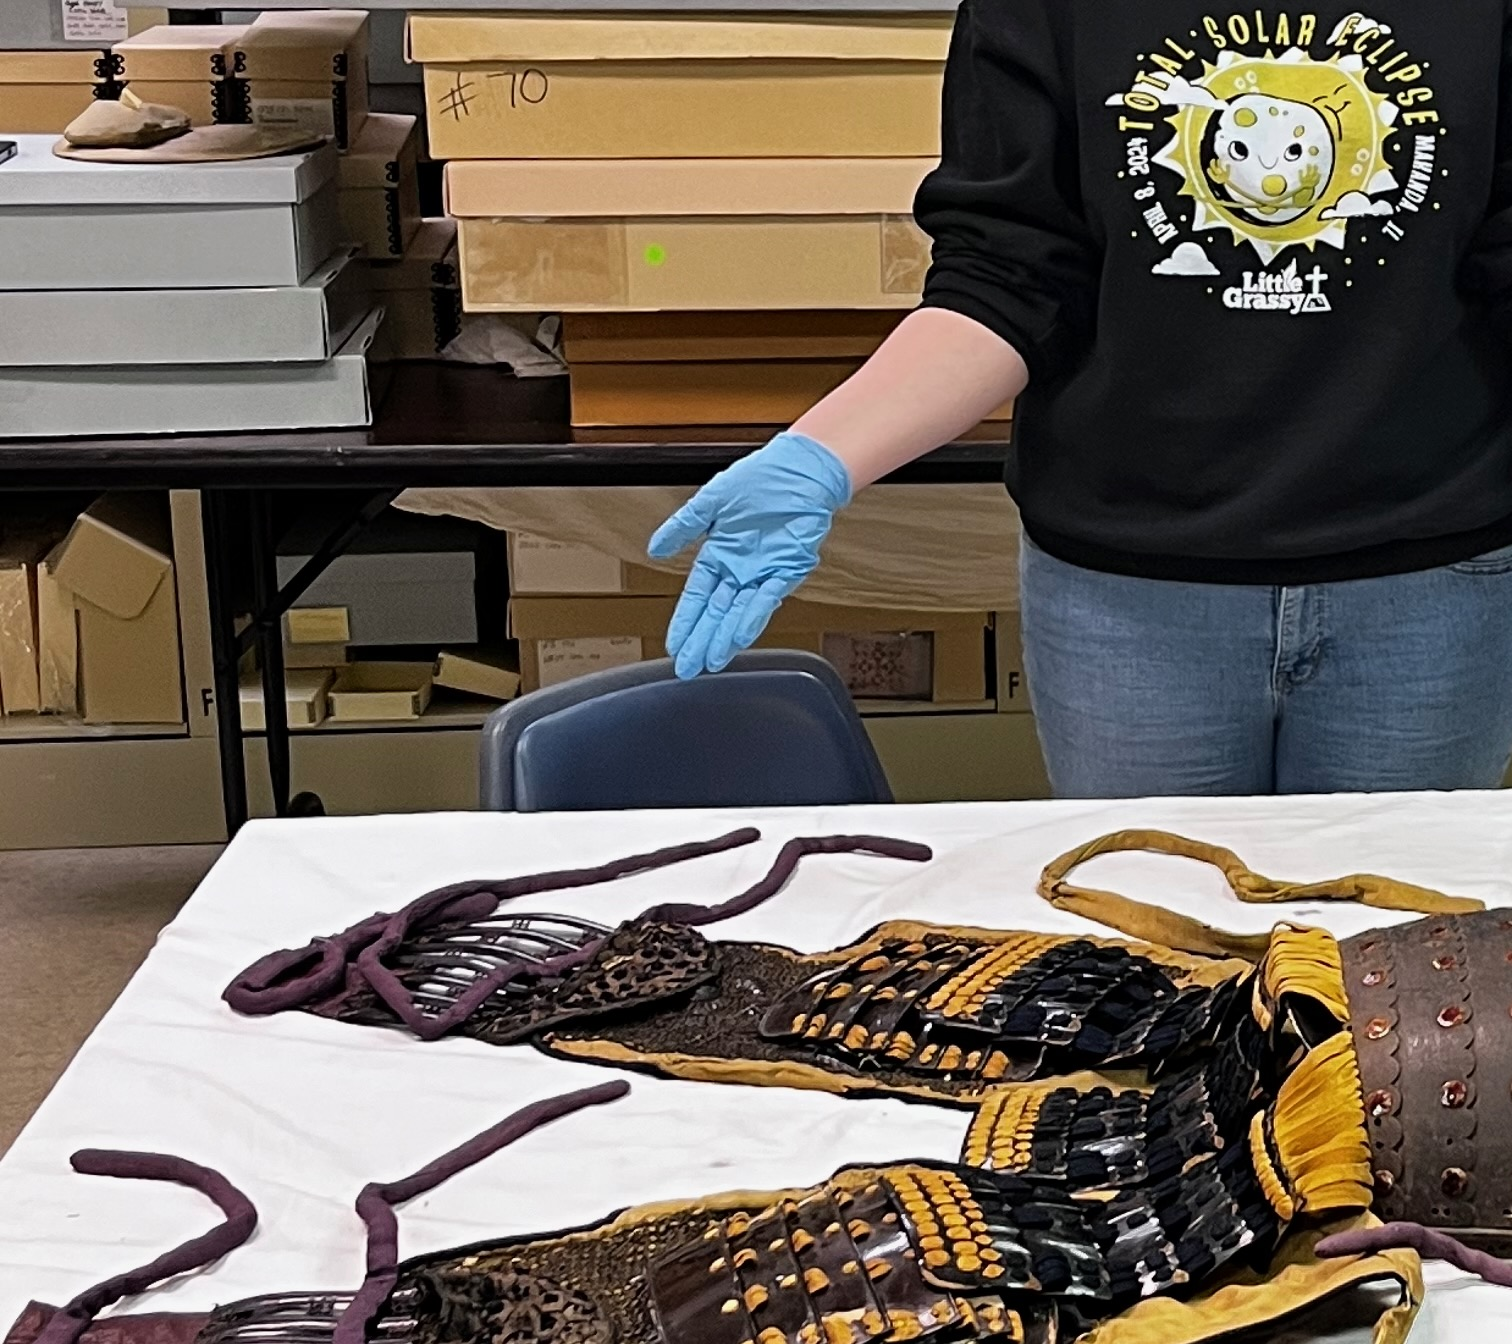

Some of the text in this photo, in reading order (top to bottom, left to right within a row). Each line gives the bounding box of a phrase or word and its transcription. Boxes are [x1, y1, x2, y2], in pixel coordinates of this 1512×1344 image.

[1118, 9, 1439, 131] TOTAL SOLAR ECLIPSE
[486, 68, 548, 109] 70
[1126, 136, 1179, 245] APRIL 8, 2024
[1242, 261, 1304, 294] Little
[1222, 286, 1306, 315] Grassy
[1008, 671, 1022, 699] F
[200, 688, 214, 717] F
